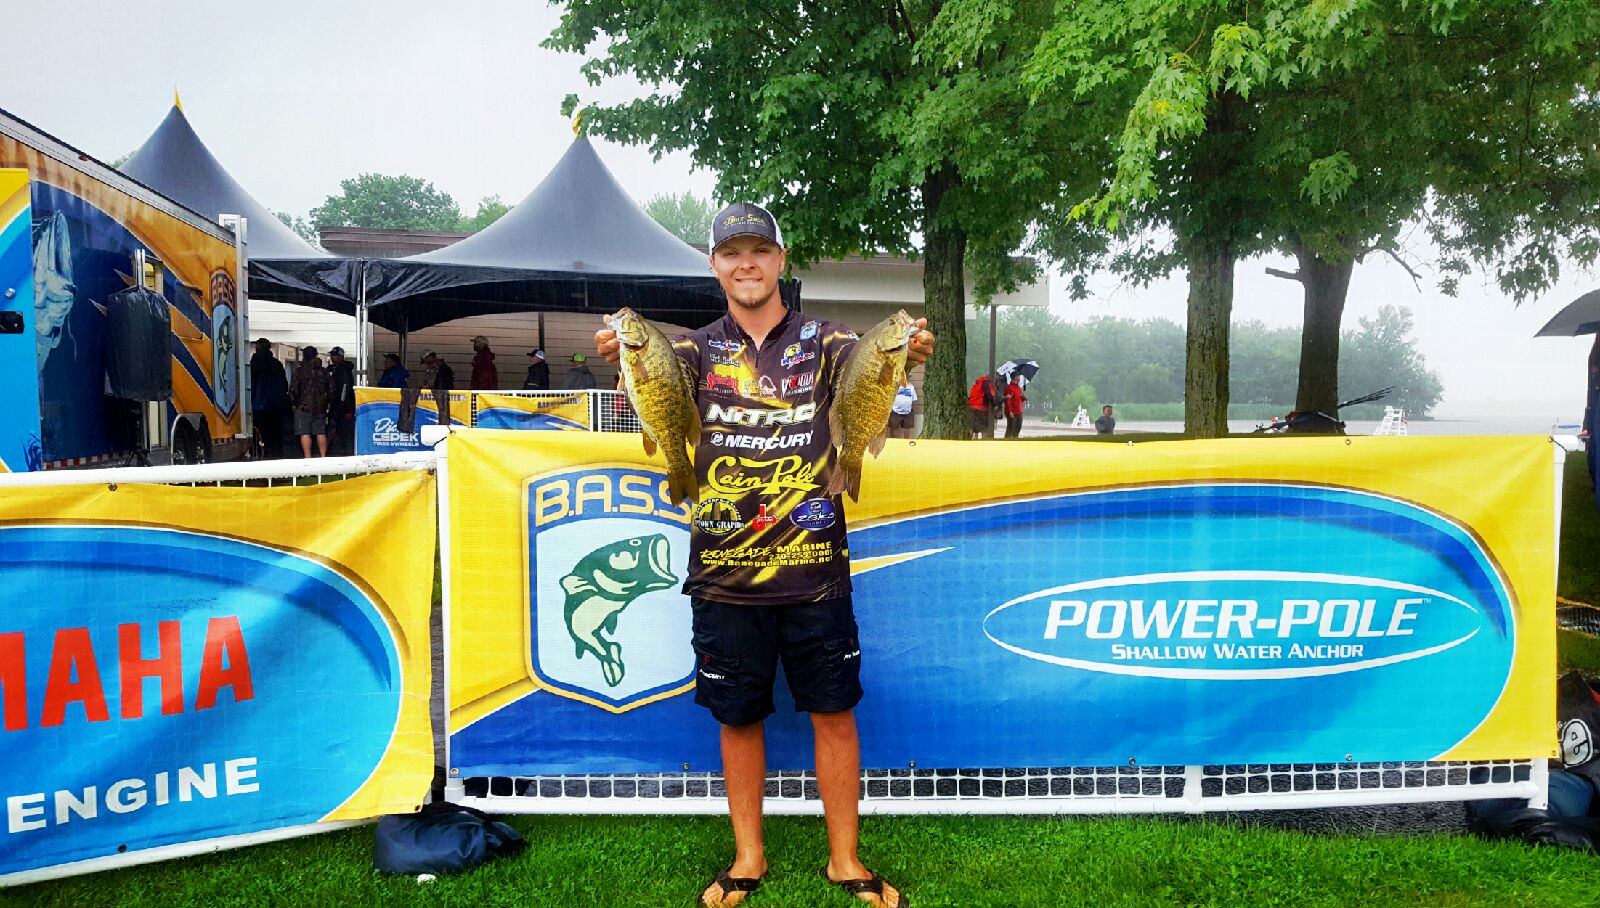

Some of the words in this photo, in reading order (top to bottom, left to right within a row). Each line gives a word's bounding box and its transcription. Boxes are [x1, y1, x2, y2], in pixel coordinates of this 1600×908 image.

[725, 430, 814, 449] MERCURY
[776, 541, 832, 553] MARINE
[1044, 598, 1423, 640] POWER-POLE
[0, 615, 255, 732] AHA
[6, 757, 260, 834] ENGINE
